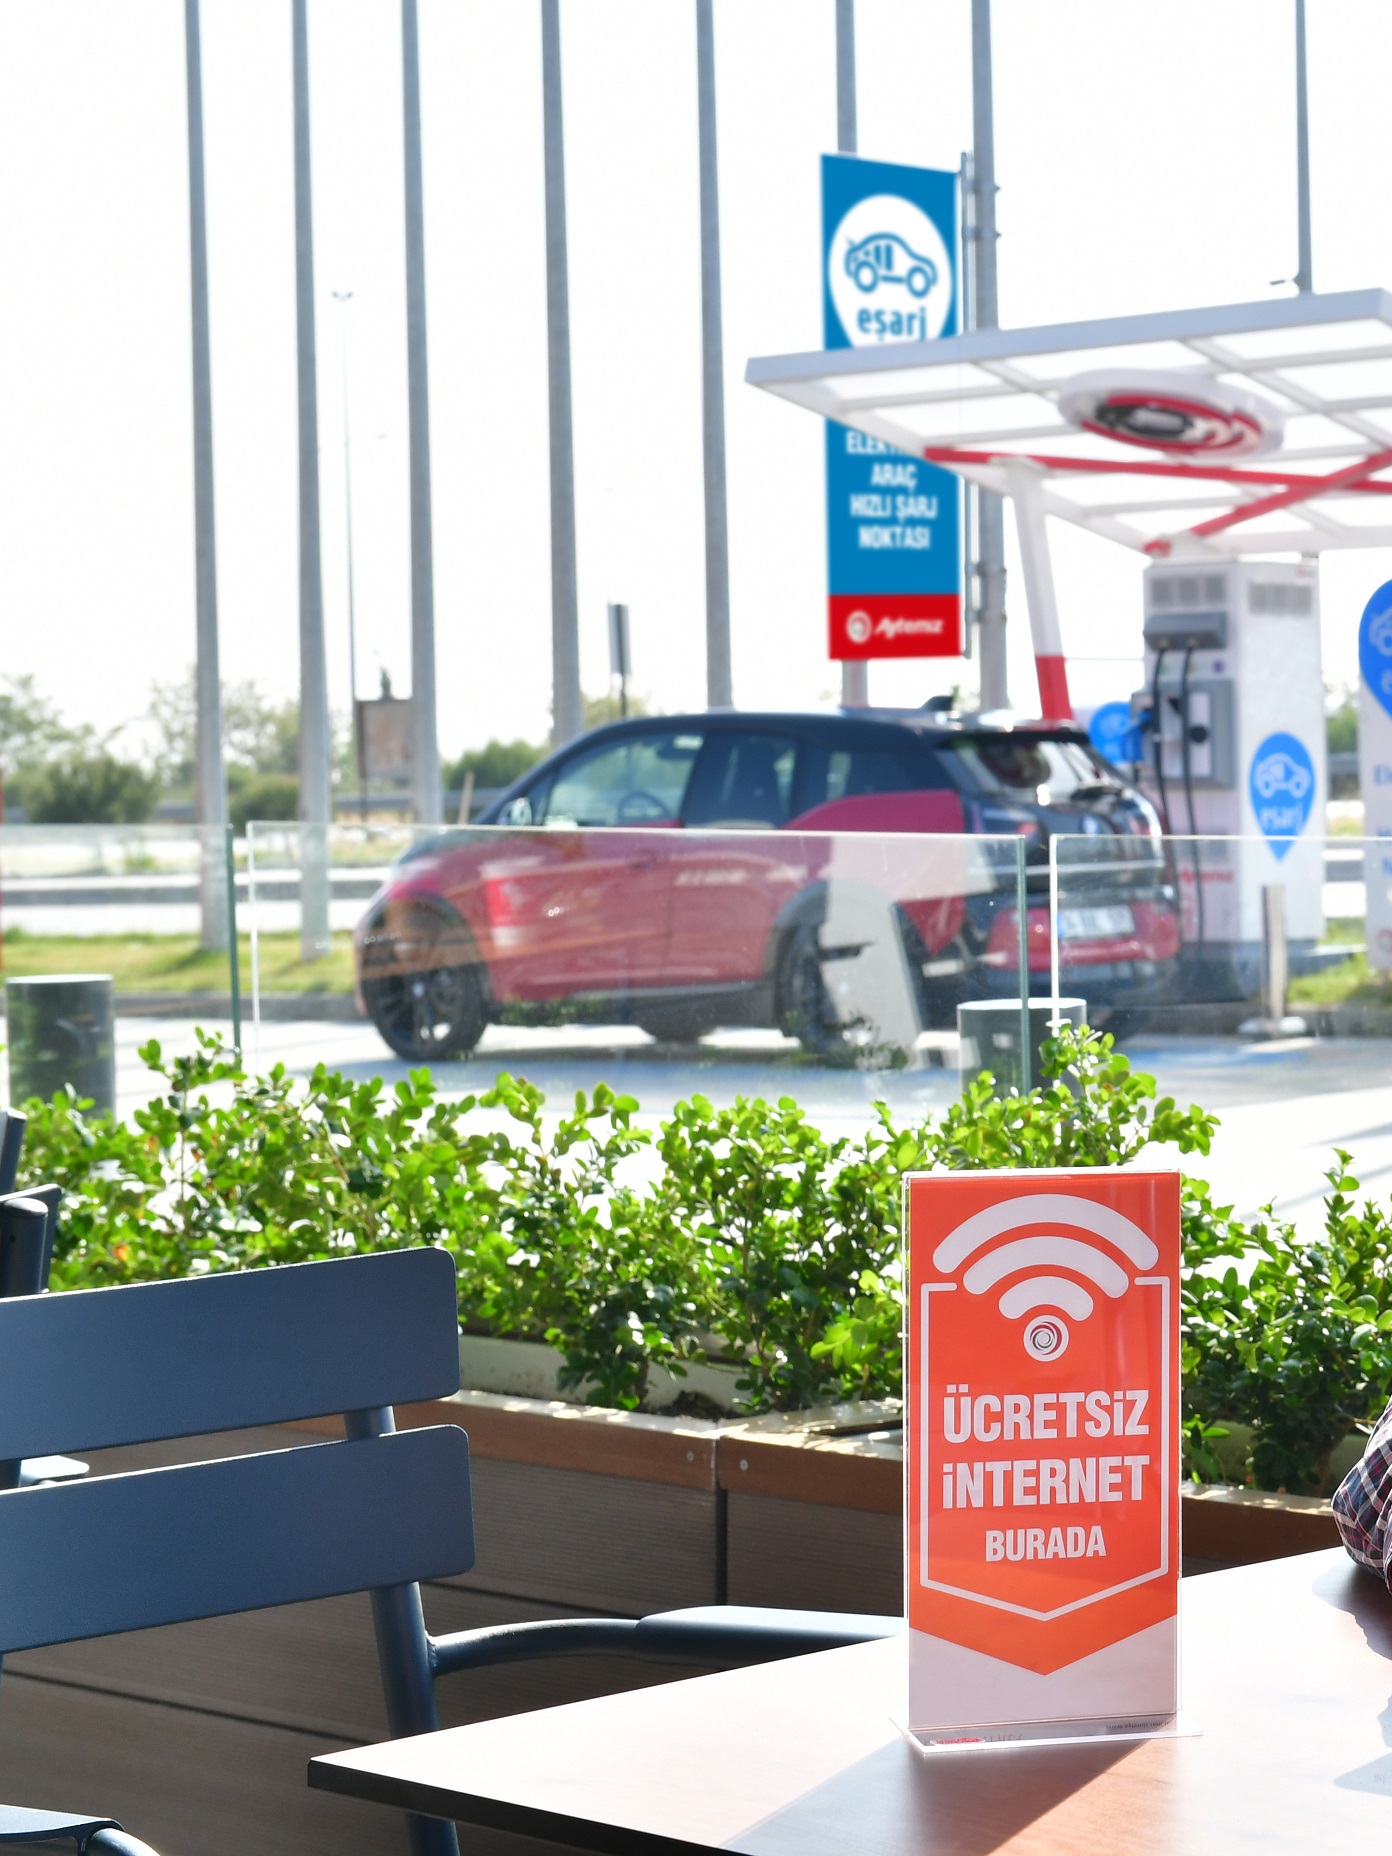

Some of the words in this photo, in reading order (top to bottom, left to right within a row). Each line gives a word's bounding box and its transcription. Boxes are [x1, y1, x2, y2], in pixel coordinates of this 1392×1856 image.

[871, 463, 918, 493] ARAÇ
[850, 494, 892, 518] HIZLI
[858, 525, 931, 549] NOKTASI
[985, 1526, 1107, 1563] BURADA
